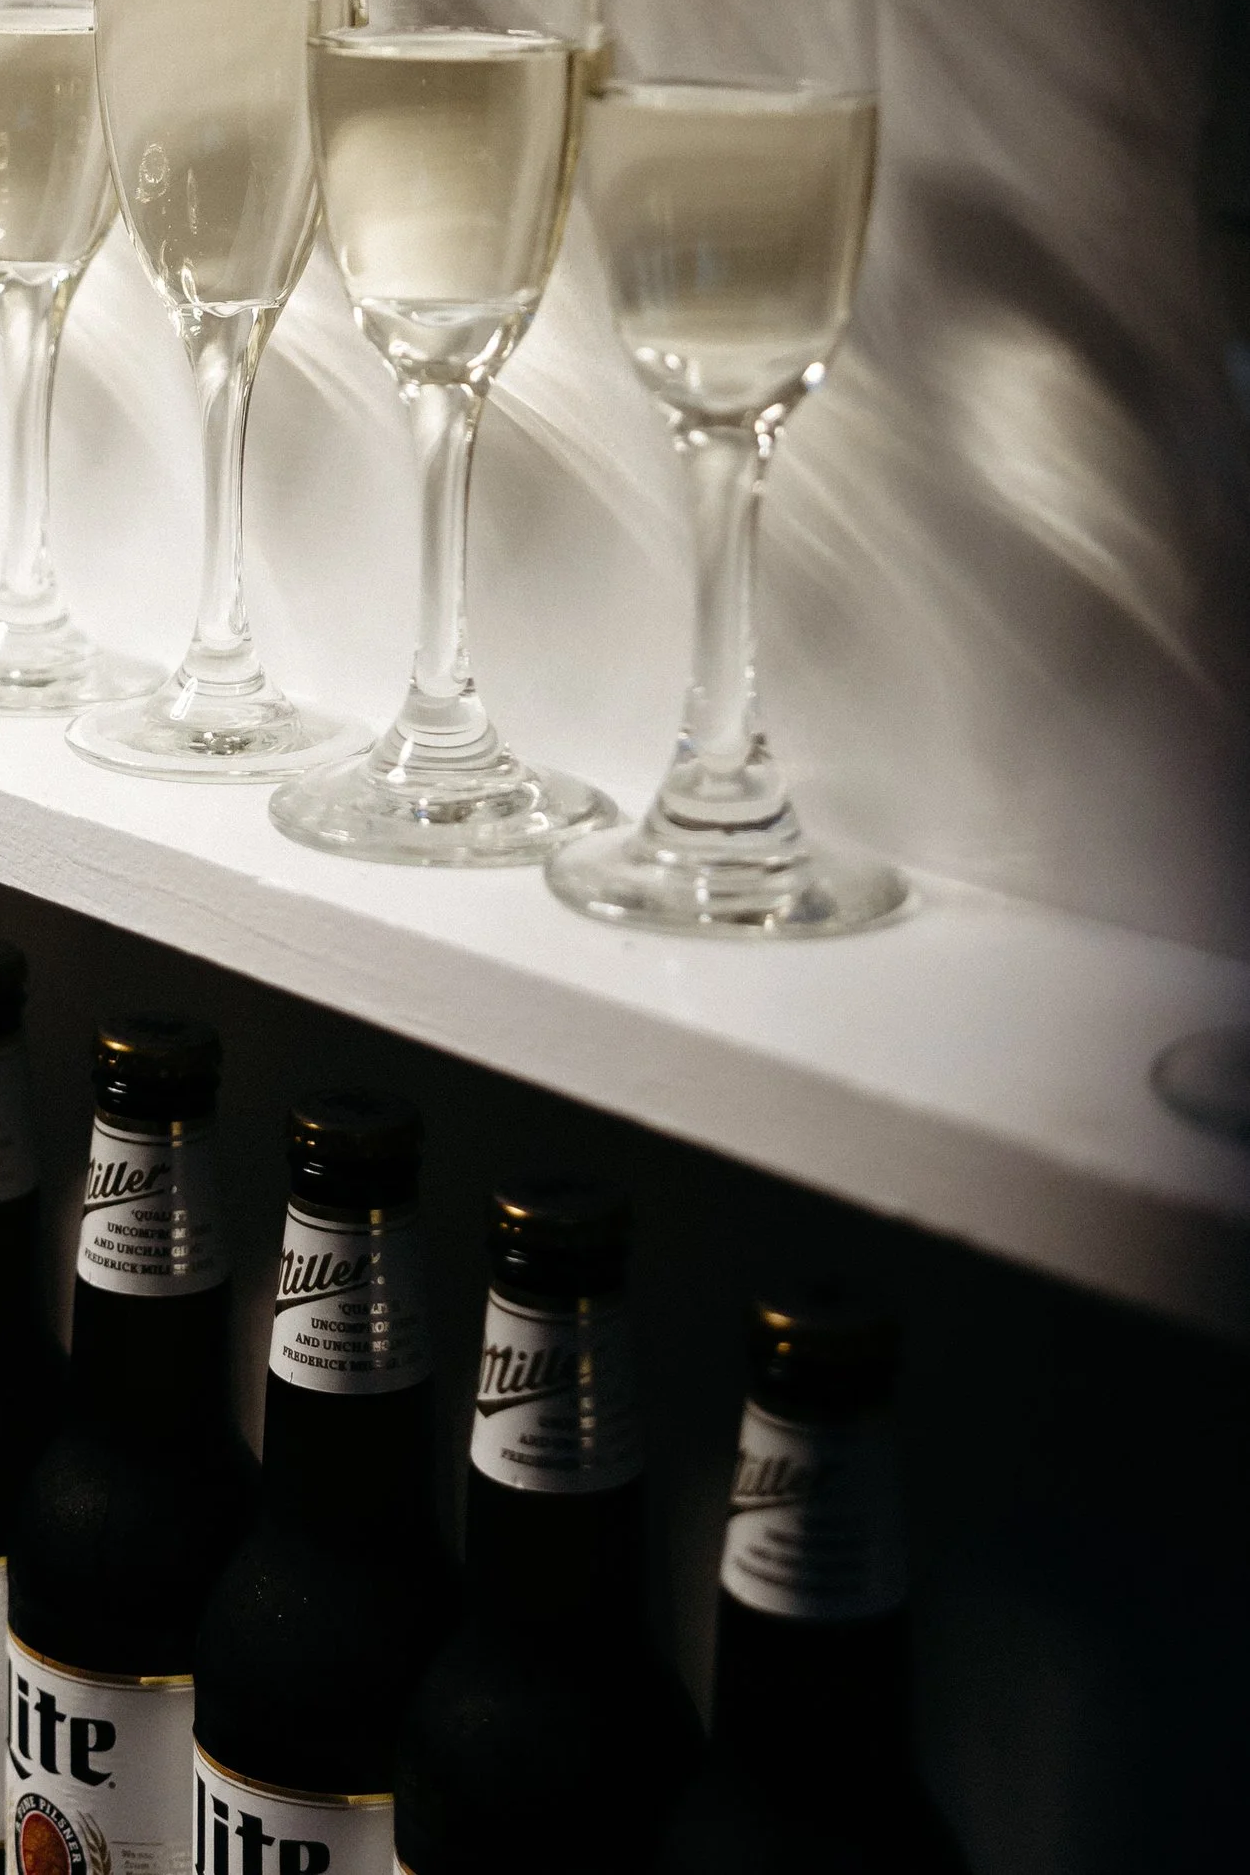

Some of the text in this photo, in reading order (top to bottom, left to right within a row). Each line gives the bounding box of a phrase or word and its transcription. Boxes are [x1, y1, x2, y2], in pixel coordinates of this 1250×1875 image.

[93, 1236, 115, 1251] AND
[295, 1332, 320, 1348] AND
[282, 1345, 347, 1372] FREDERICK
[39, 1797, 82, 1864] PILSNER
